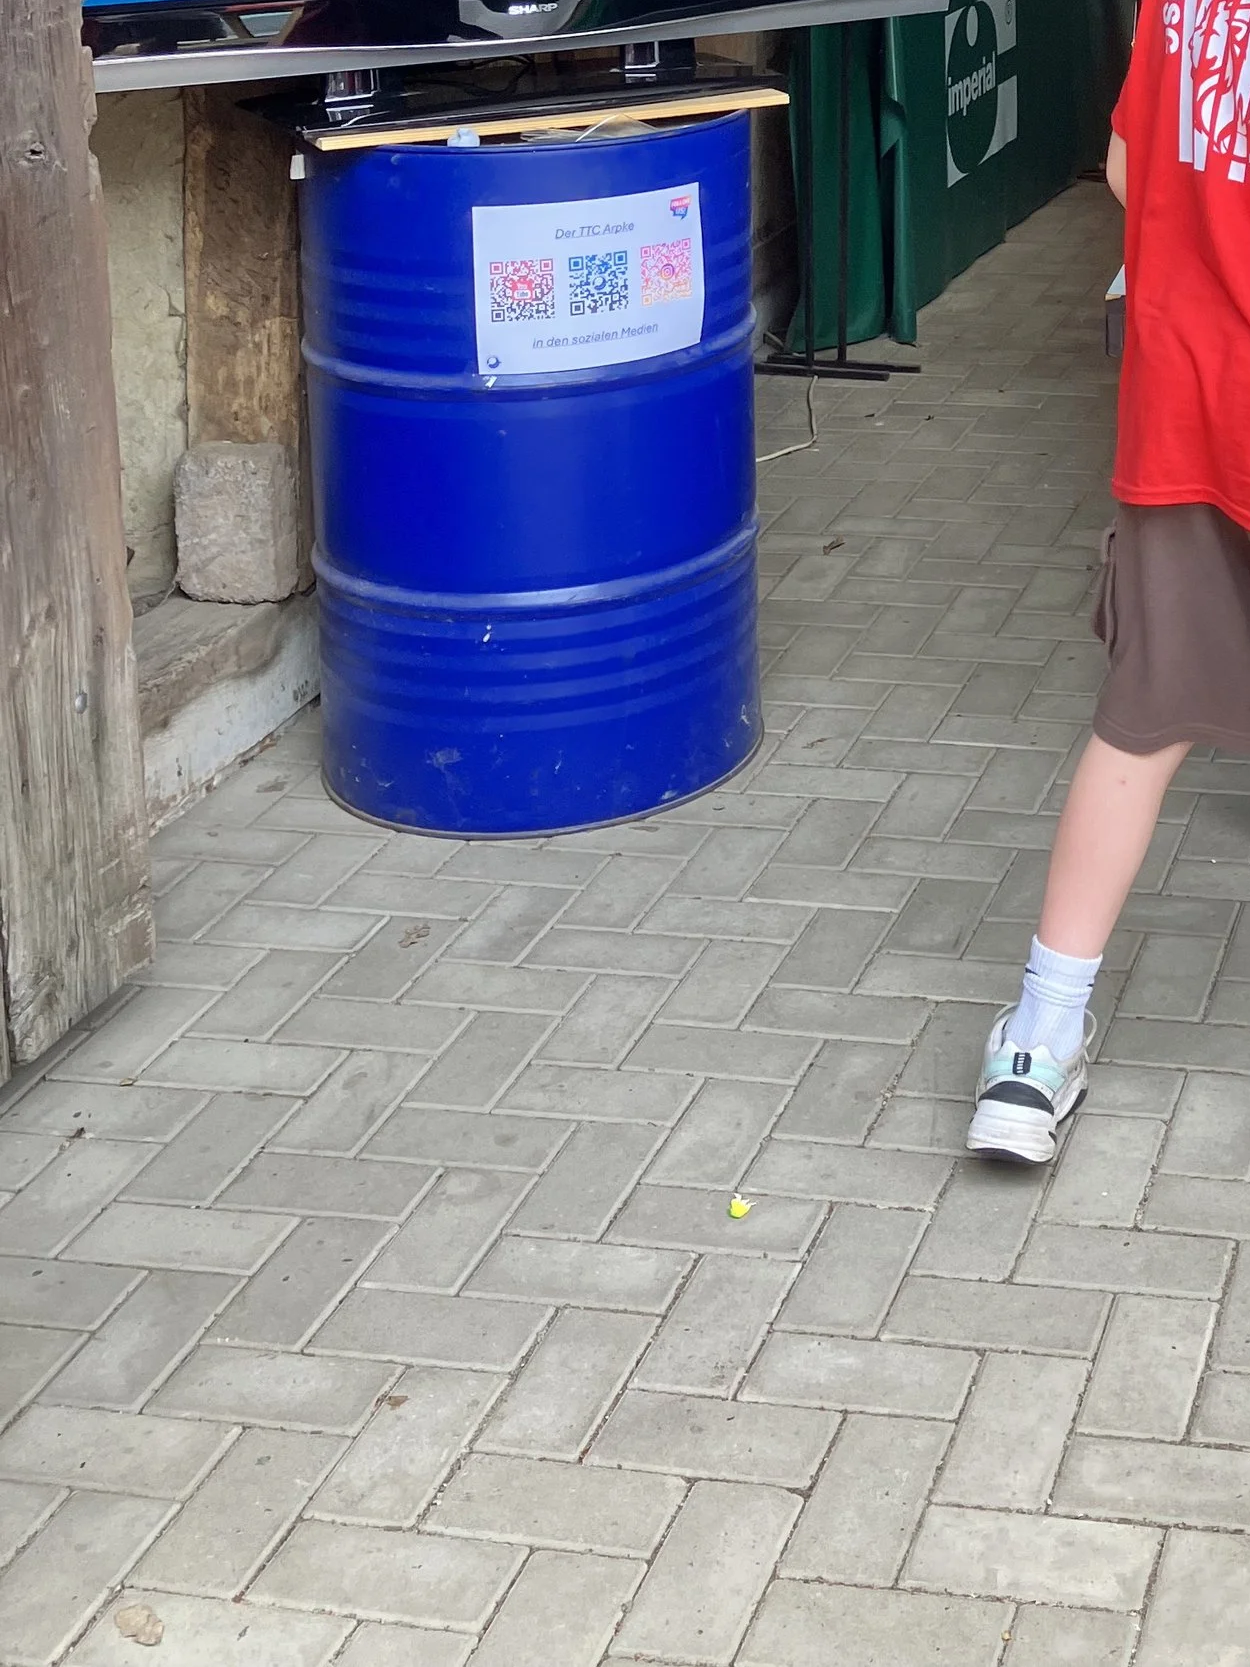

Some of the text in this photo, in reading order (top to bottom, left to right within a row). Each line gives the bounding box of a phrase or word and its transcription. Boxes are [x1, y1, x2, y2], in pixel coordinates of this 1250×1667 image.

[508, 2, 558, 15] SHARP
[947, 51, 996, 117] imperial
[555, 221, 635, 239] Der TTC Arpke
[532, 323, 659, 349] in den sozialen Medien
